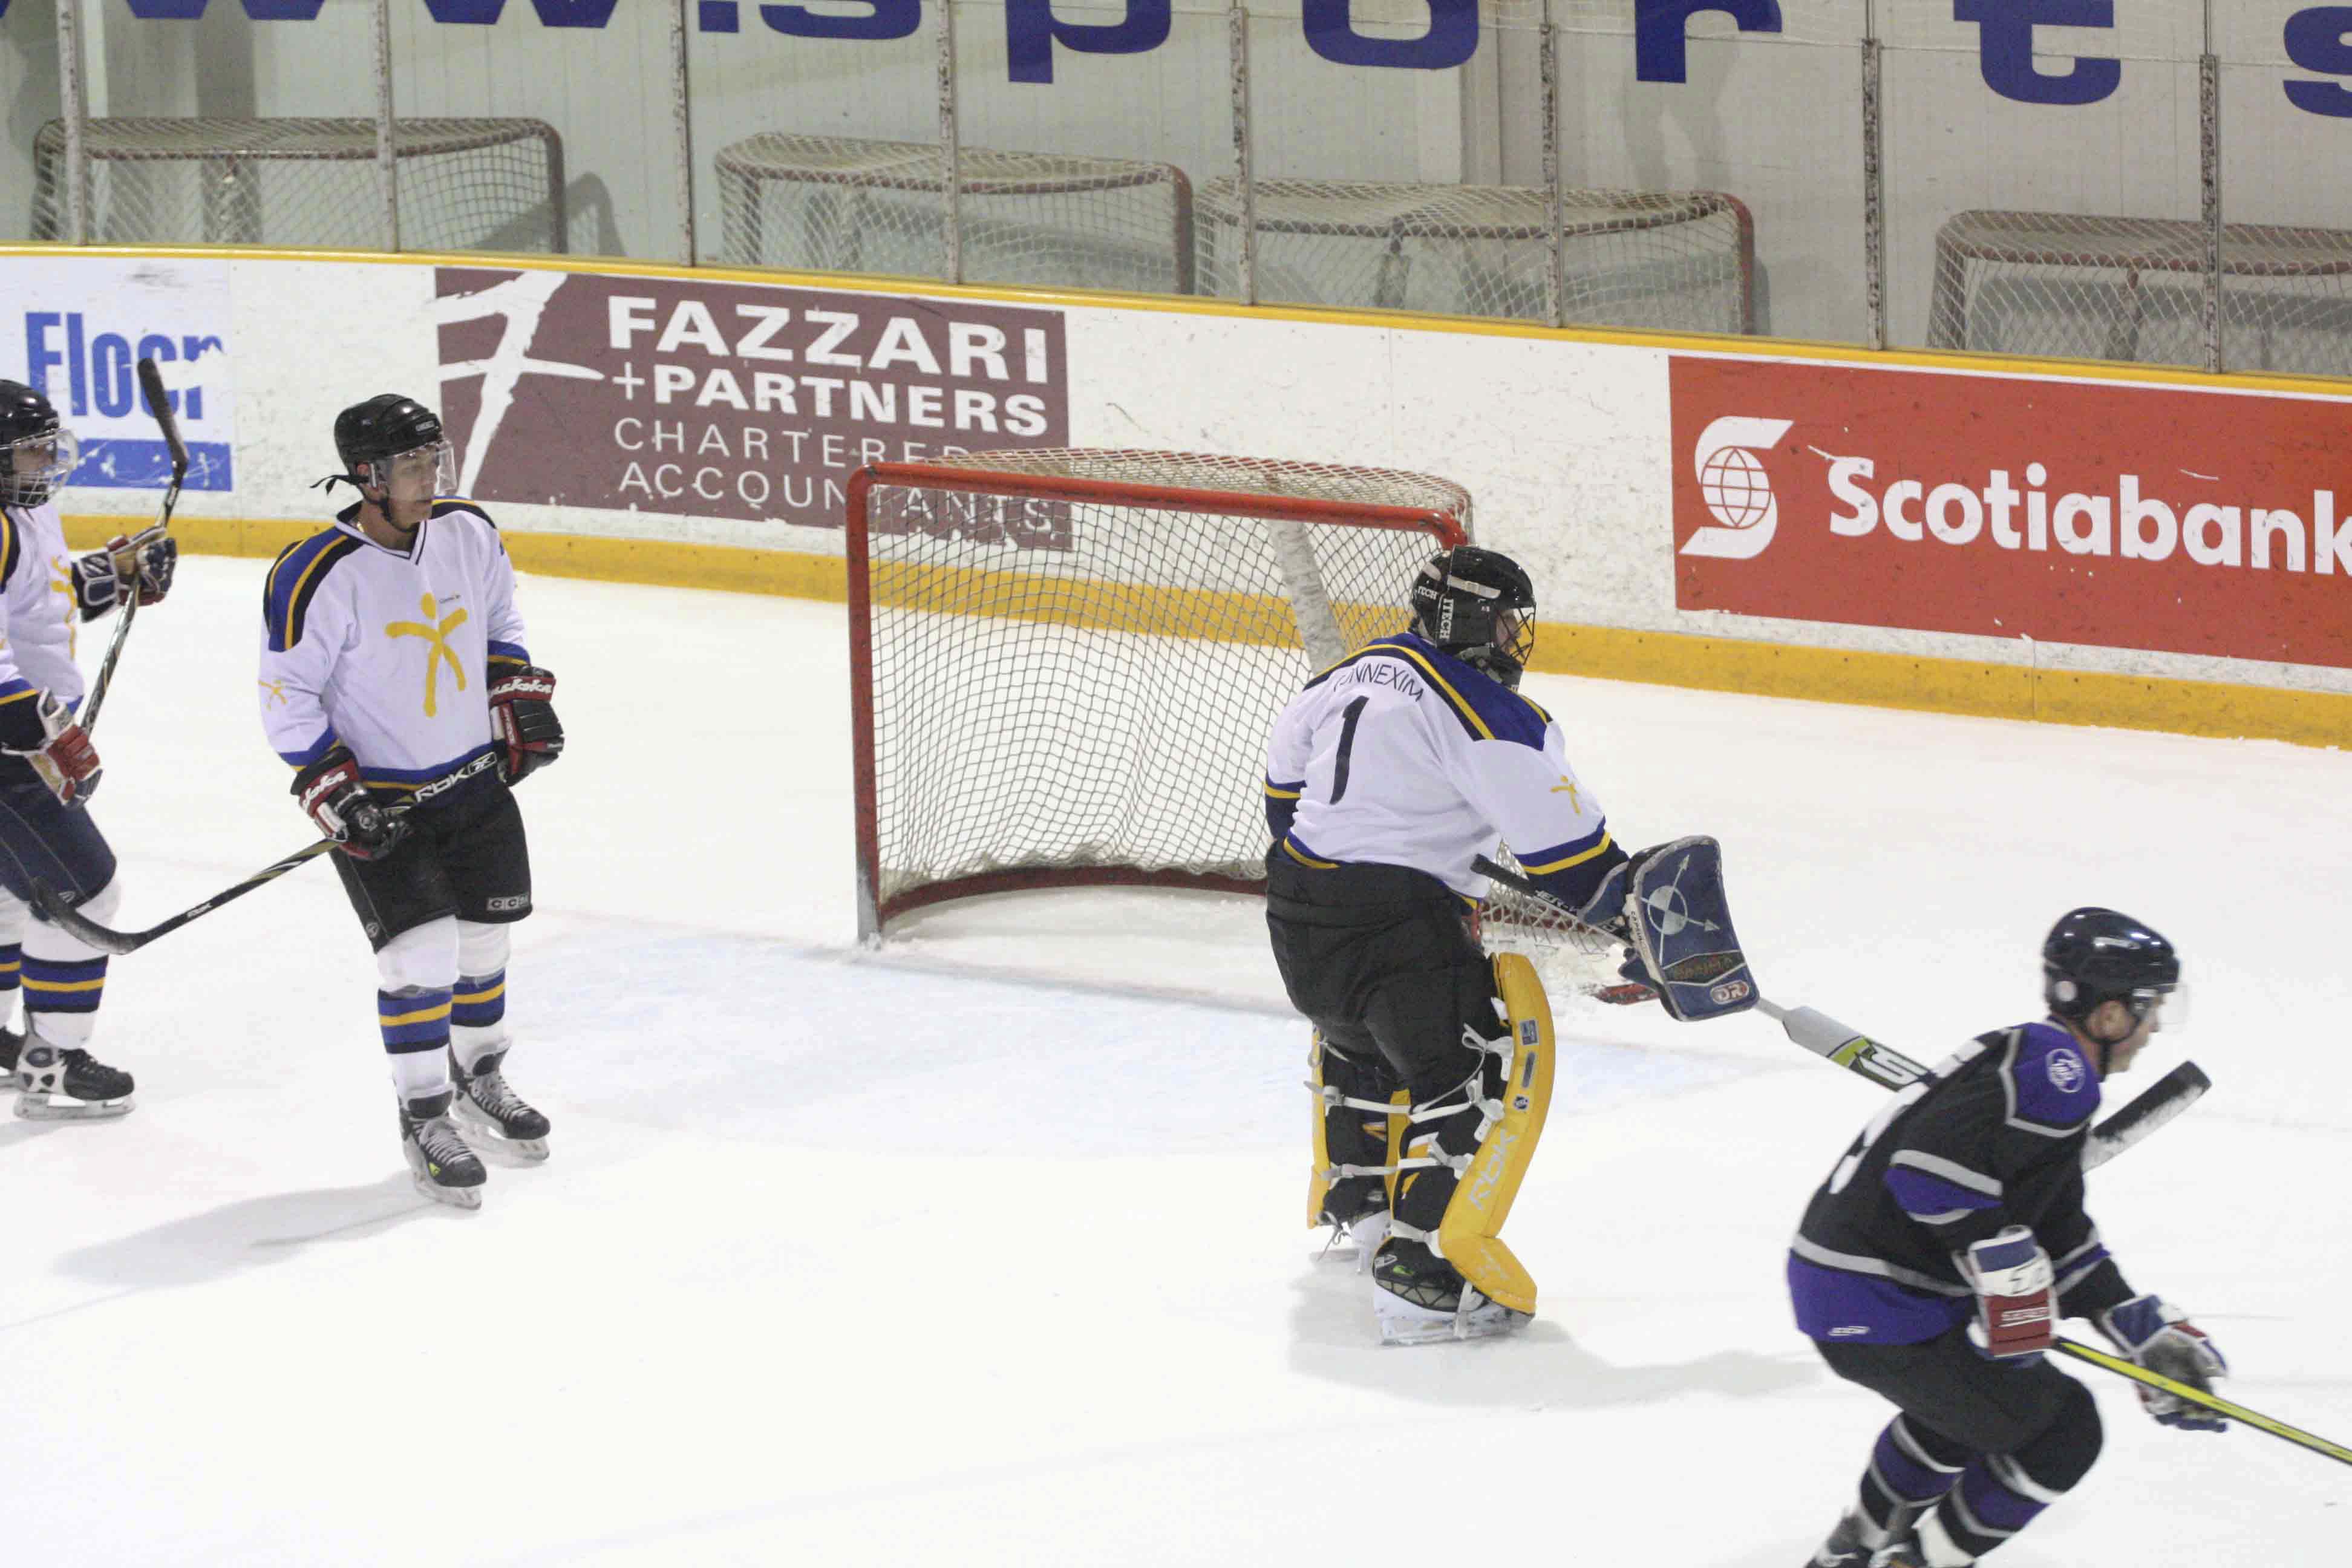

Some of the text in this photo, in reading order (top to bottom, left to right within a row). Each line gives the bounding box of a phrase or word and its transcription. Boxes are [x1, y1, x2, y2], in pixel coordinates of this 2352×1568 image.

[607, 294, 1048, 384] FAZZARI
[1827, 455, 2352, 575] Scotiabank
[1439, 598, 1454, 640] ITECH
[1330, 695, 1370, 805] 1
